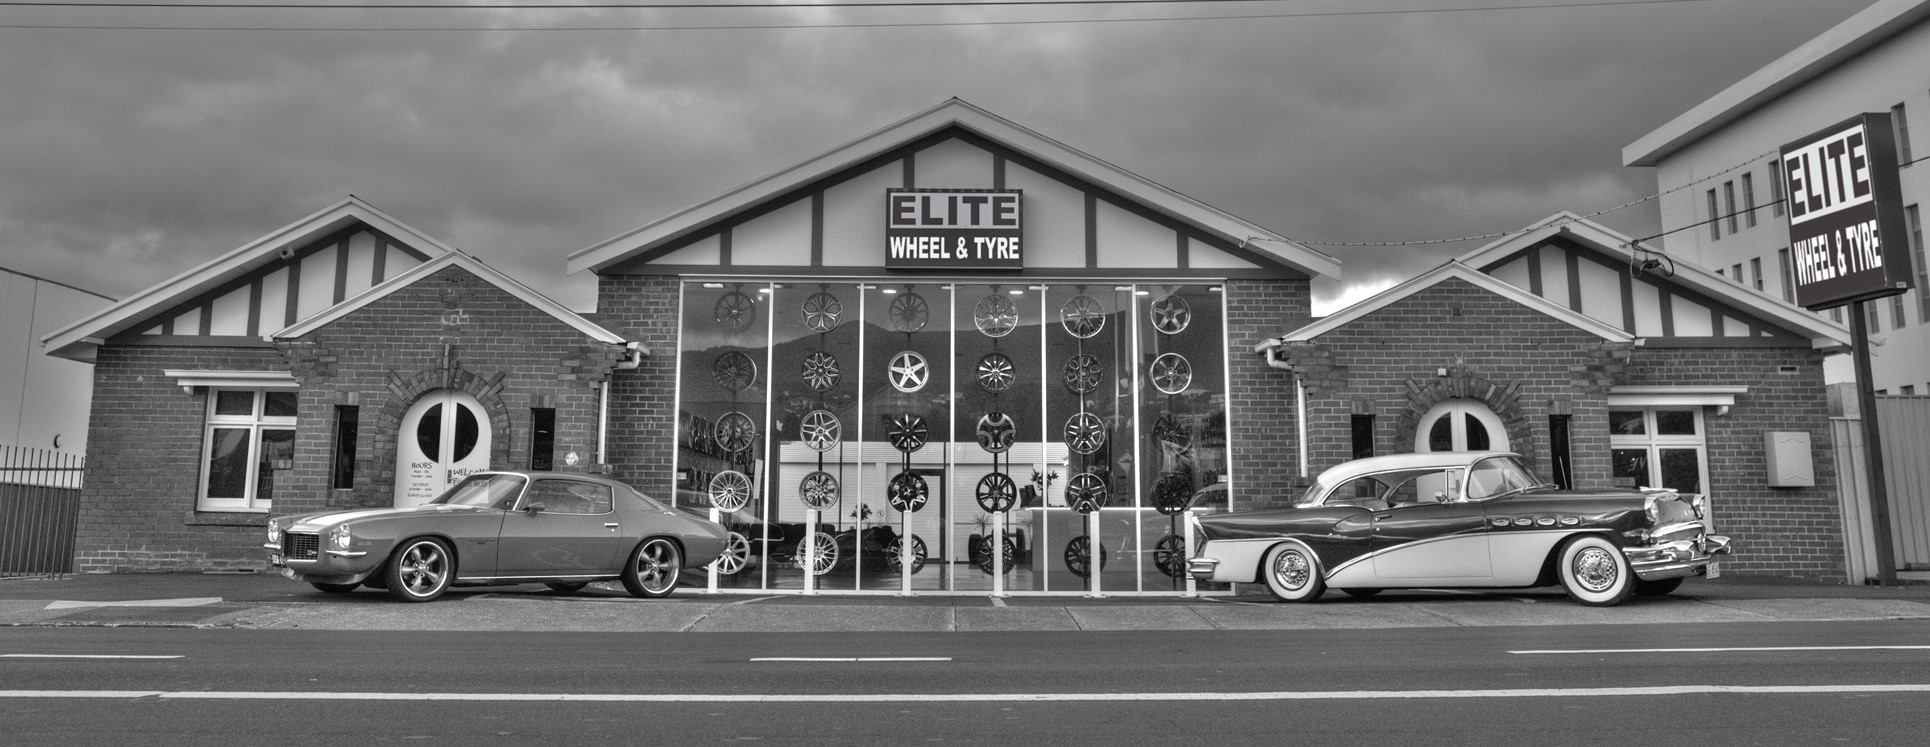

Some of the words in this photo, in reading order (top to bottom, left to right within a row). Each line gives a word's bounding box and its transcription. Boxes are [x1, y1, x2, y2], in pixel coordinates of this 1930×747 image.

[1786, 131, 1870, 219] ELITE
[892, 195, 1016, 226] ELITE
[890, 236, 950, 259] WHEEL
[956, 236, 969, 259] &
[974, 237, 1019, 259] TYRE
[1793, 233, 1836, 286] WHEEL
[1835, 229, 1847, 277] &
[1845, 219, 1882, 273] TYRE
[453, 468, 489, 476] WELCO
